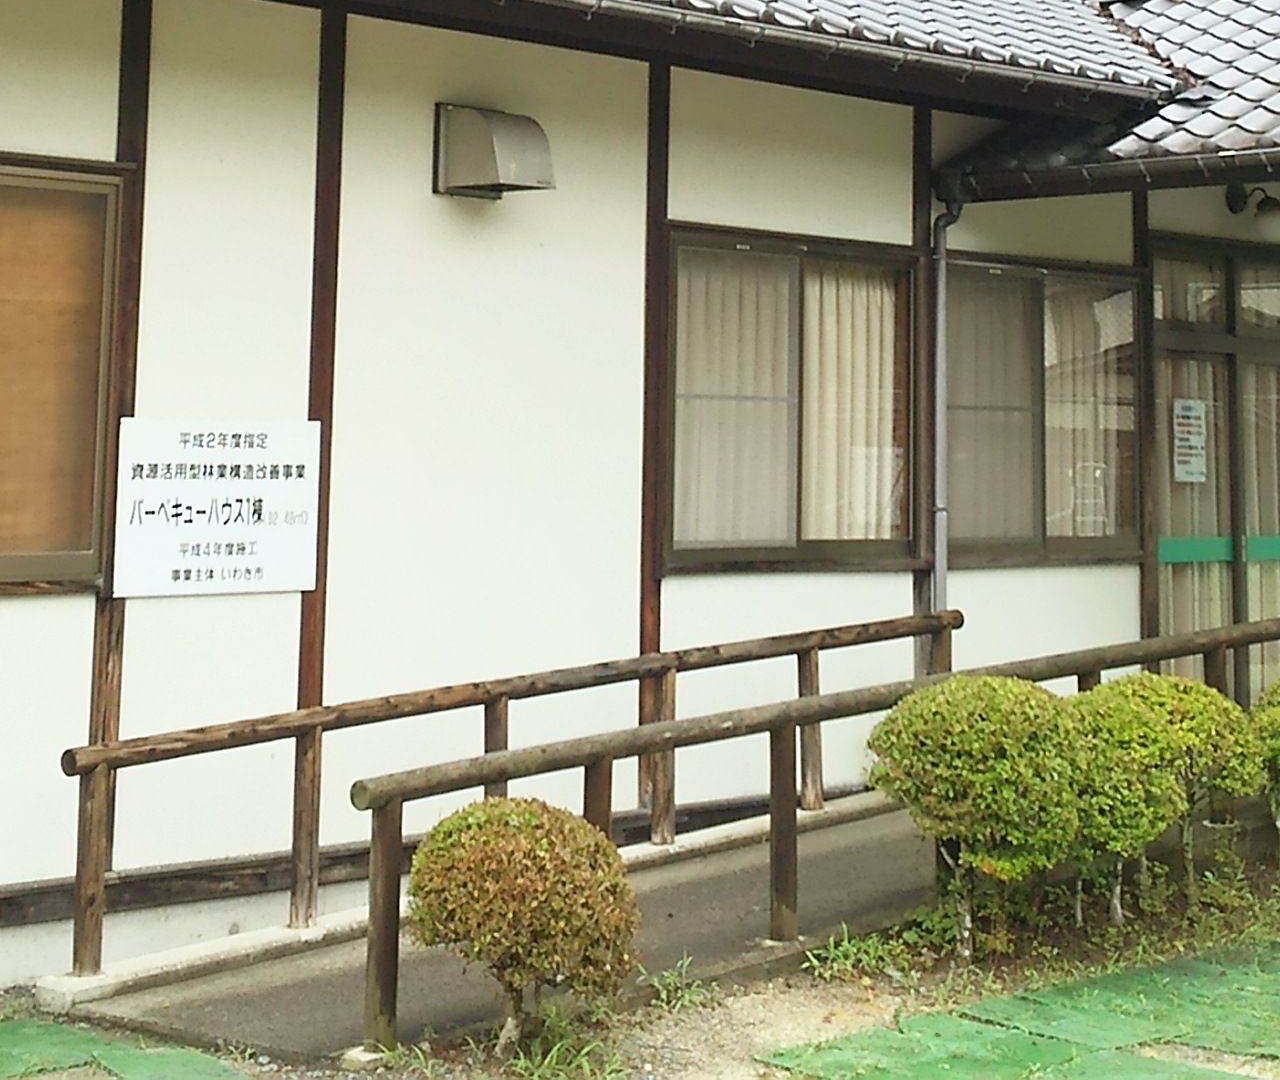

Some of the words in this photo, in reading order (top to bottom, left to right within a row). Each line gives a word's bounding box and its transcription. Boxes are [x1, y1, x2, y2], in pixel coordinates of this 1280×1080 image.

[179, 432, 269, 449] 平成2年度指定
[131, 463, 307, 481] 資源活用型林業構造改善事業
